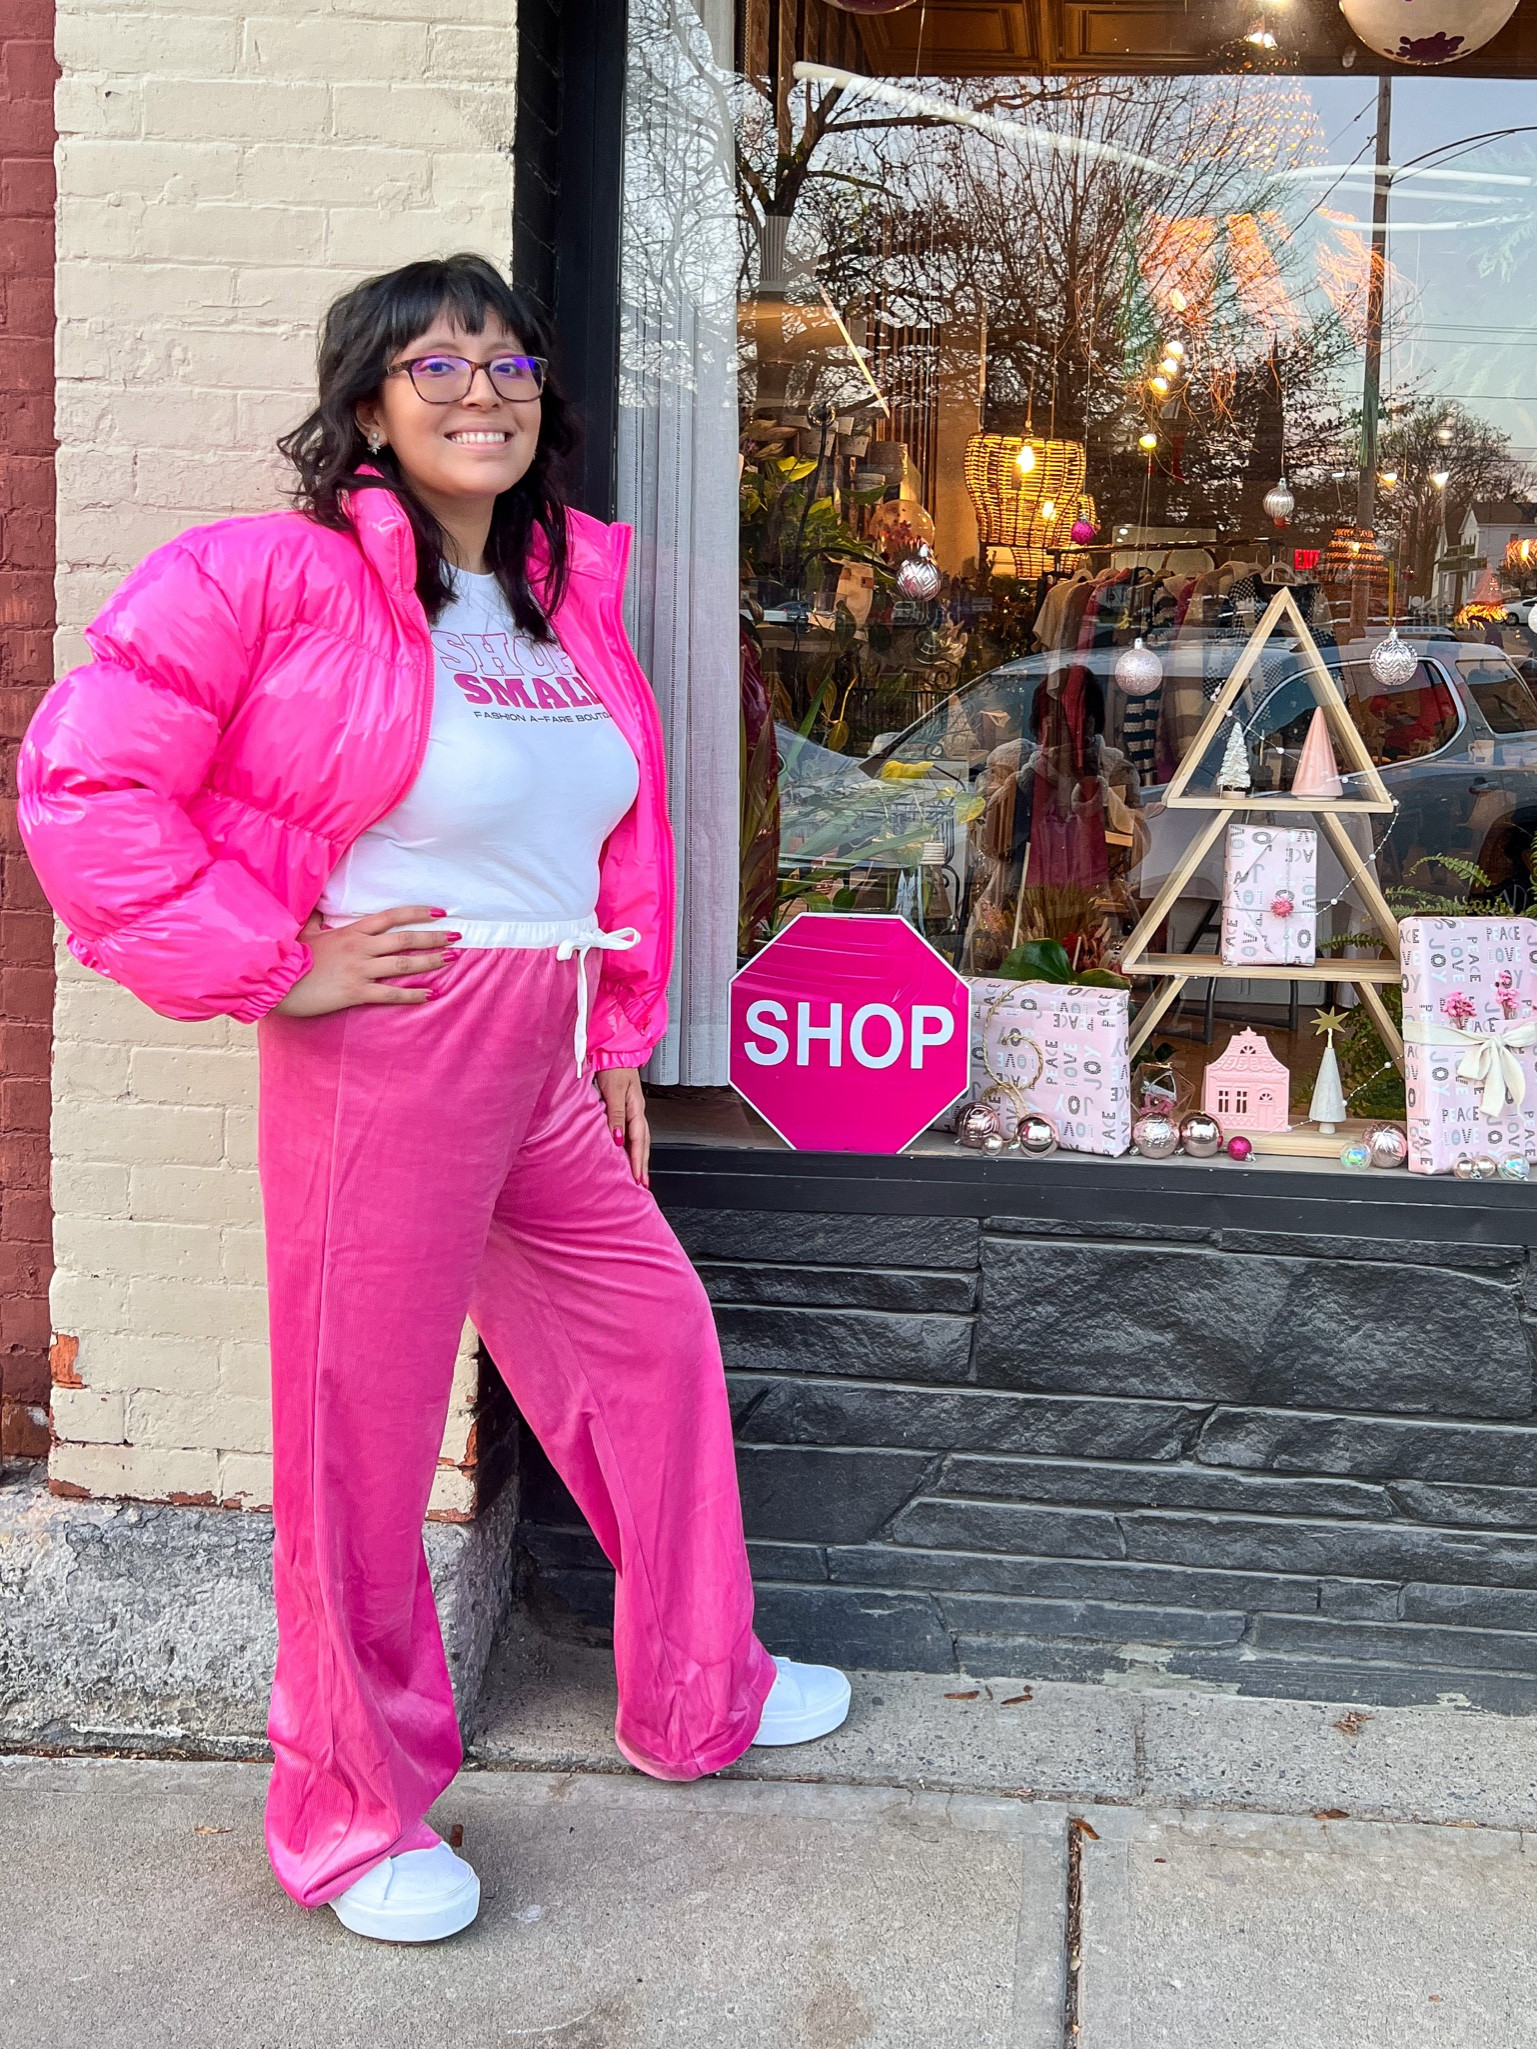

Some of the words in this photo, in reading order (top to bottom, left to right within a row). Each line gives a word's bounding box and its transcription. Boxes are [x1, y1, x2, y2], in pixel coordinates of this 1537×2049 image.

[1294, 549, 1320, 569] EXIT
[454, 673, 602, 709] SMALL
[473, 711, 526, 722] FASHION
[530, 715, 574, 723] A-FARE
[1230, 825, 1245, 857] LOV
[1285, 848, 1315, 863] ACE
[1399, 929, 1420, 944] ACE
[1486, 925, 1521, 942] PEACE
[1429, 937, 1447, 983] JOY
[1450, 937, 1466, 983] LOVE
[1467, 936, 1482, 983] PEACE
[1487, 945, 1521, 964] LOVE
[1401, 974, 1422, 993] OY
[743, 1000, 955, 1070] SHOP
[1045, 1039, 1059, 1085] PEACE
[1063, 1042, 1078, 1087] LOVE
[1083, 1044, 1102, 1091] JOY
[1430, 1051, 1450, 1097] JOY
[1055, 1093, 1094, 1117] JOY
[1441, 1106, 1480, 1124] PEACE
[1443, 1127, 1481, 1147] LOVE
[1523, 1111, 1536, 1157] PEACE
